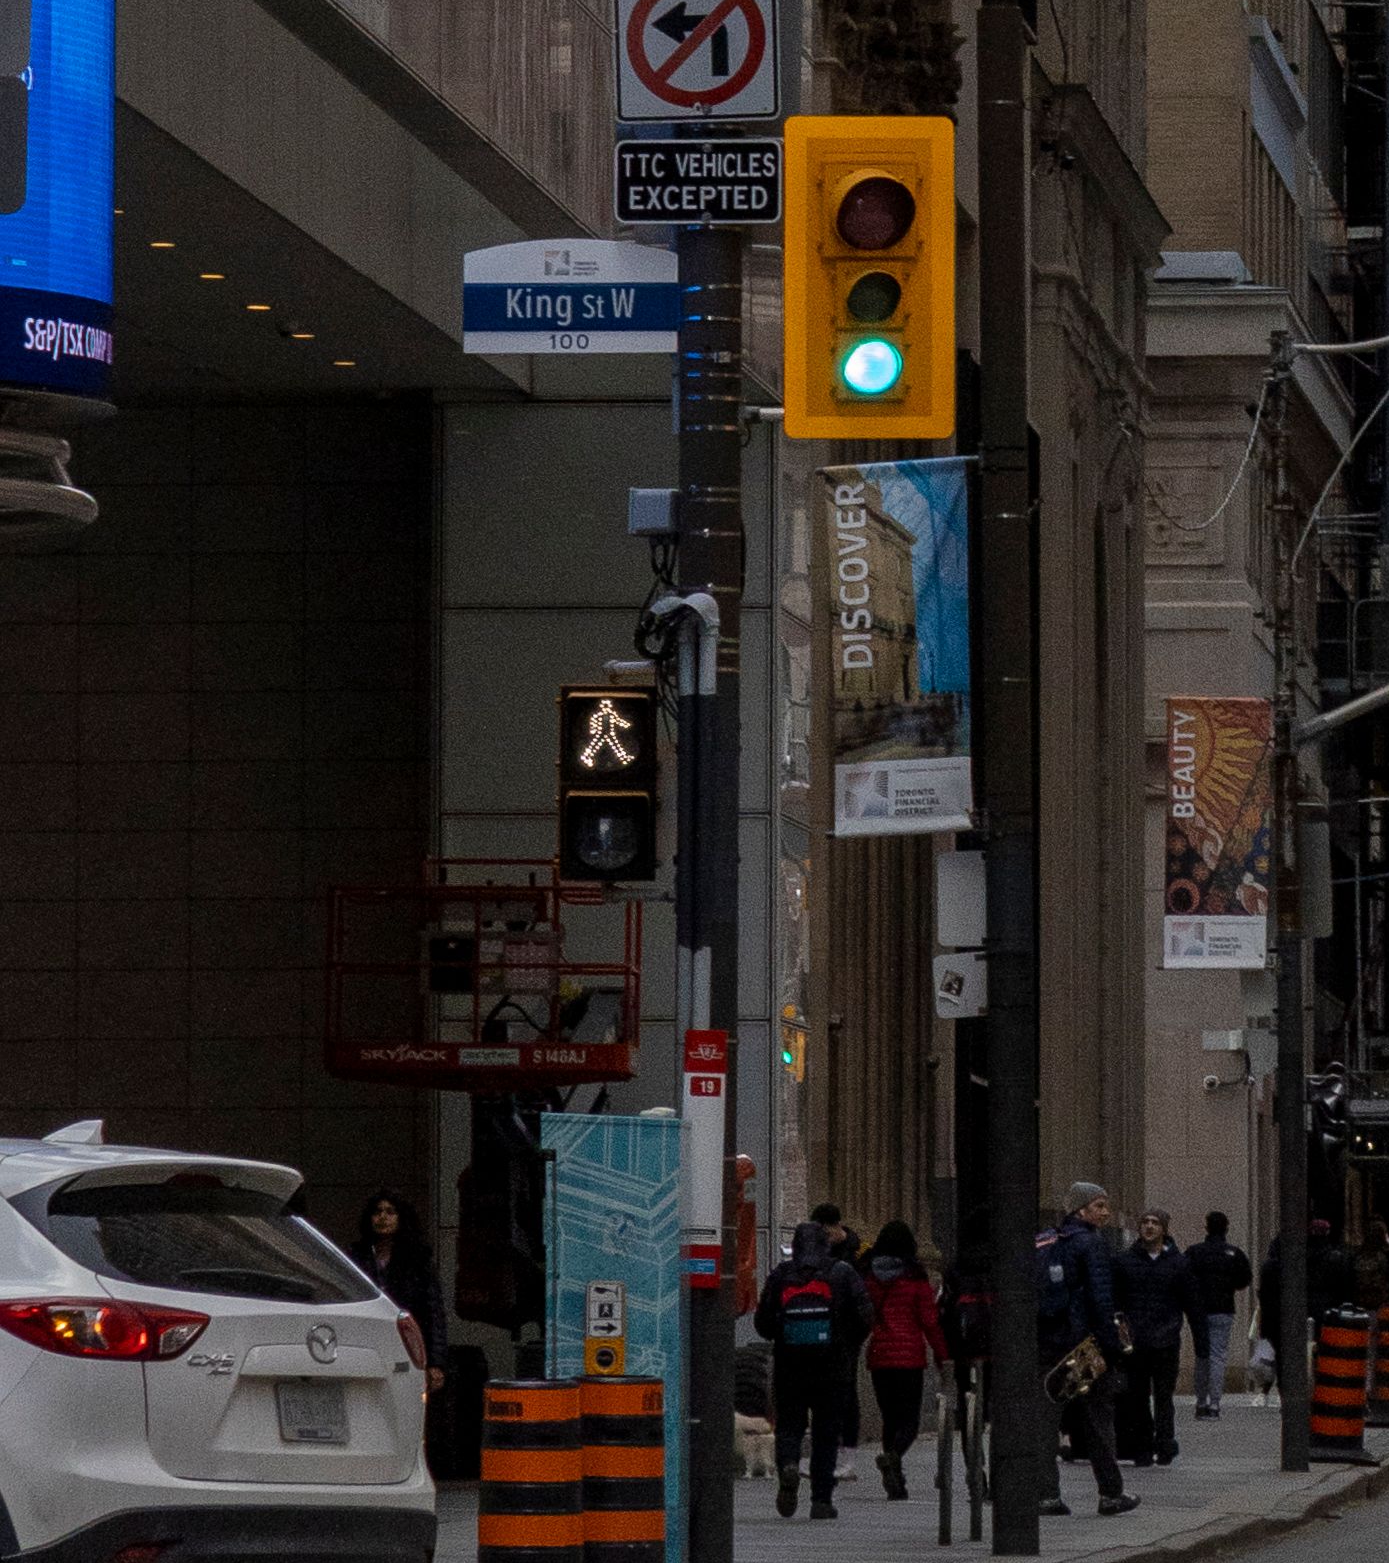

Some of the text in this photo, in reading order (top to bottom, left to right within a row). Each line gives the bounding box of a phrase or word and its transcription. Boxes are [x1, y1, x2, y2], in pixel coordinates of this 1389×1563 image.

[622, 153, 776, 177] TTC VEHICLES
[629, 186, 768, 210] EXCEPTED
[506, 288, 635, 326] King St W
[551, 334, 589, 350] 100
[835, 482, 873, 670] DISCOVER
[1173, 710, 1197, 819] BEAUTY
[361, 1045, 447, 1062] SKYJACK
[701, 1079, 715, 1093] 19
